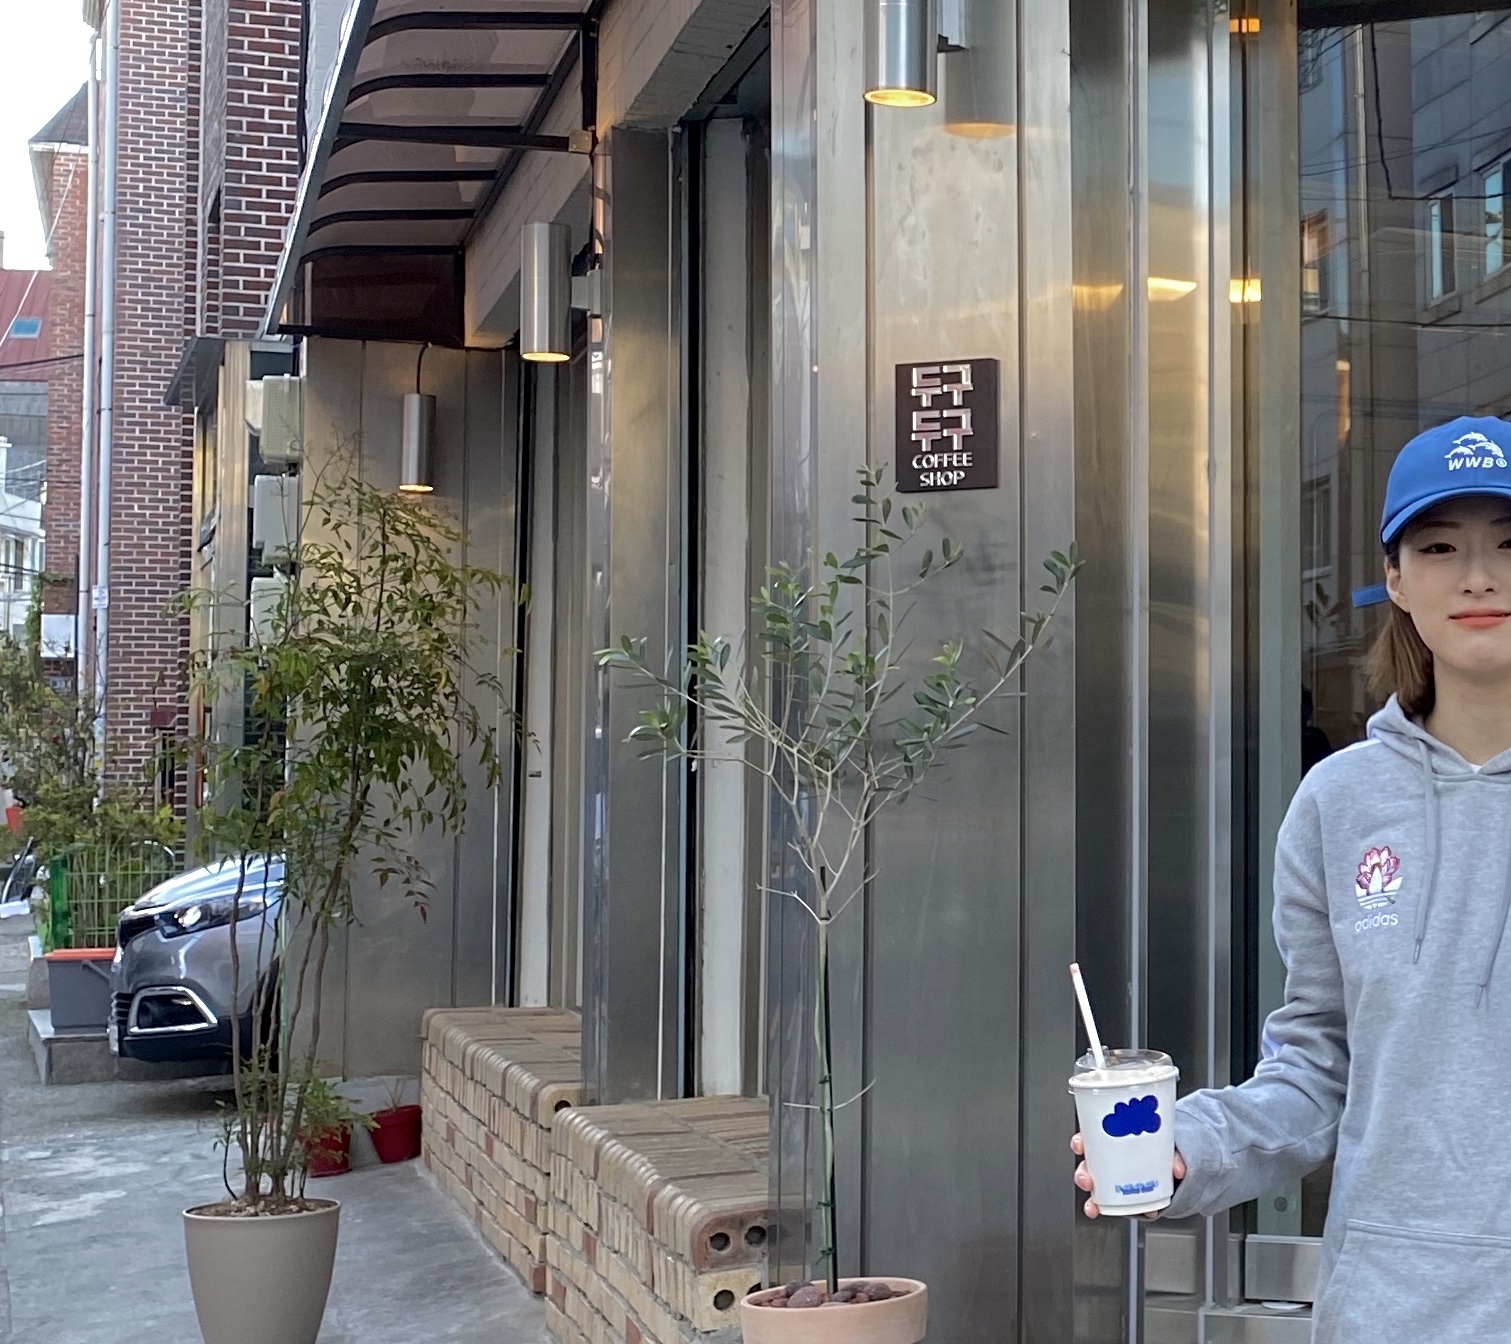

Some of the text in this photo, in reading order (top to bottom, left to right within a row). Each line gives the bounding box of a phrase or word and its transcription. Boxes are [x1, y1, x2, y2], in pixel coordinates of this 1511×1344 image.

[911, 452, 974, 469] COFFEE
[919, 470, 966, 487] SHOP
[1354, 912, 1399, 933] adidas
